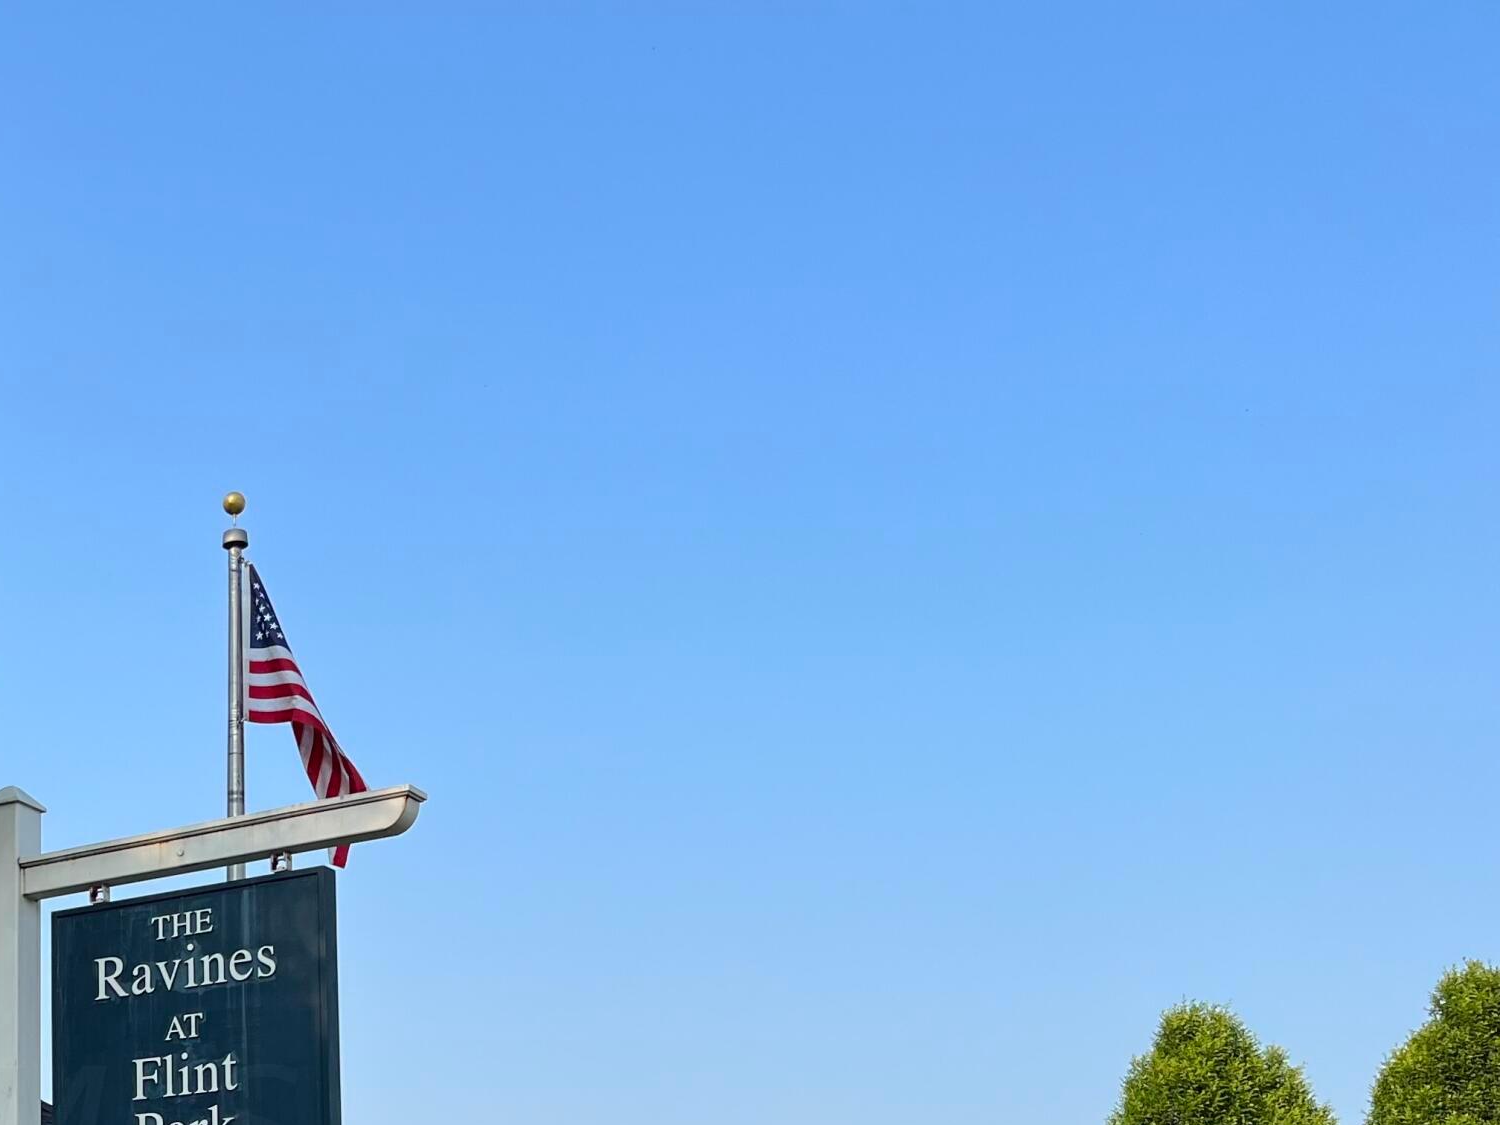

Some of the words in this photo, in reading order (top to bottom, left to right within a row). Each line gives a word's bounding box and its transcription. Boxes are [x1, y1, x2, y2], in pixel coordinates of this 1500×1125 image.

[151, 908, 214, 941] THE
[94, 943, 276, 1001] Ravines
[164, 1012, 204, 1041] AT
[131, 1052, 238, 1101] Flint
